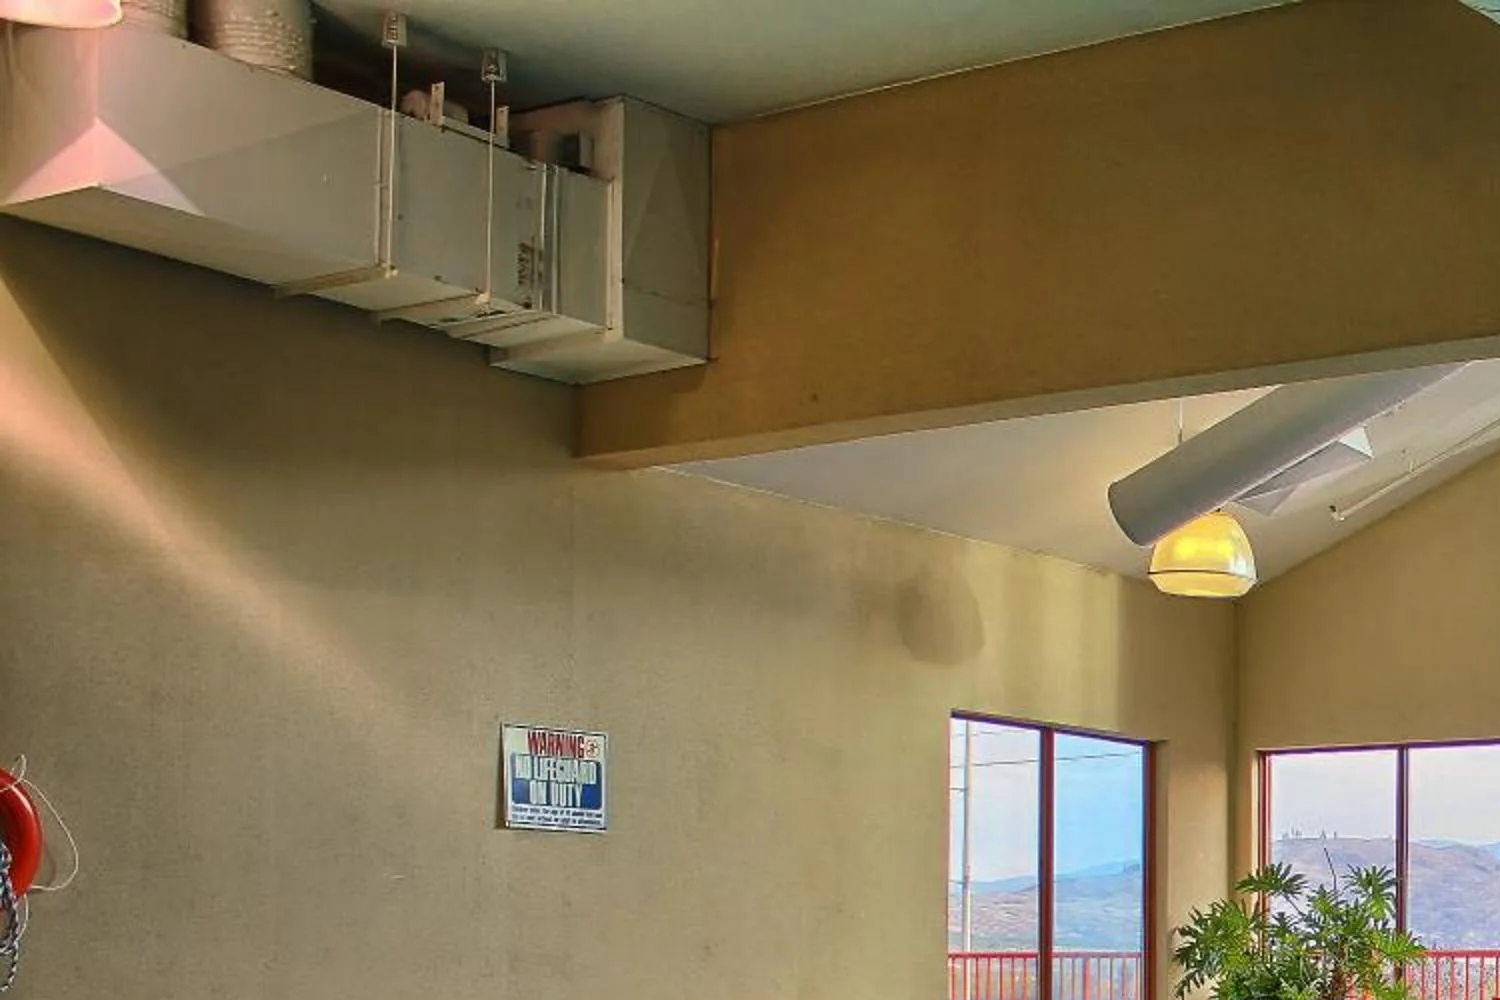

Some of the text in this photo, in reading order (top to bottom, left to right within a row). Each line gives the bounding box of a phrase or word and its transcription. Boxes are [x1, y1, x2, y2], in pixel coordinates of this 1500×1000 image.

[527, 730, 585, 759] WARNING
[515, 755, 597, 785] NO LIFEGUARD
[529, 780, 583, 807] ON DUTY
